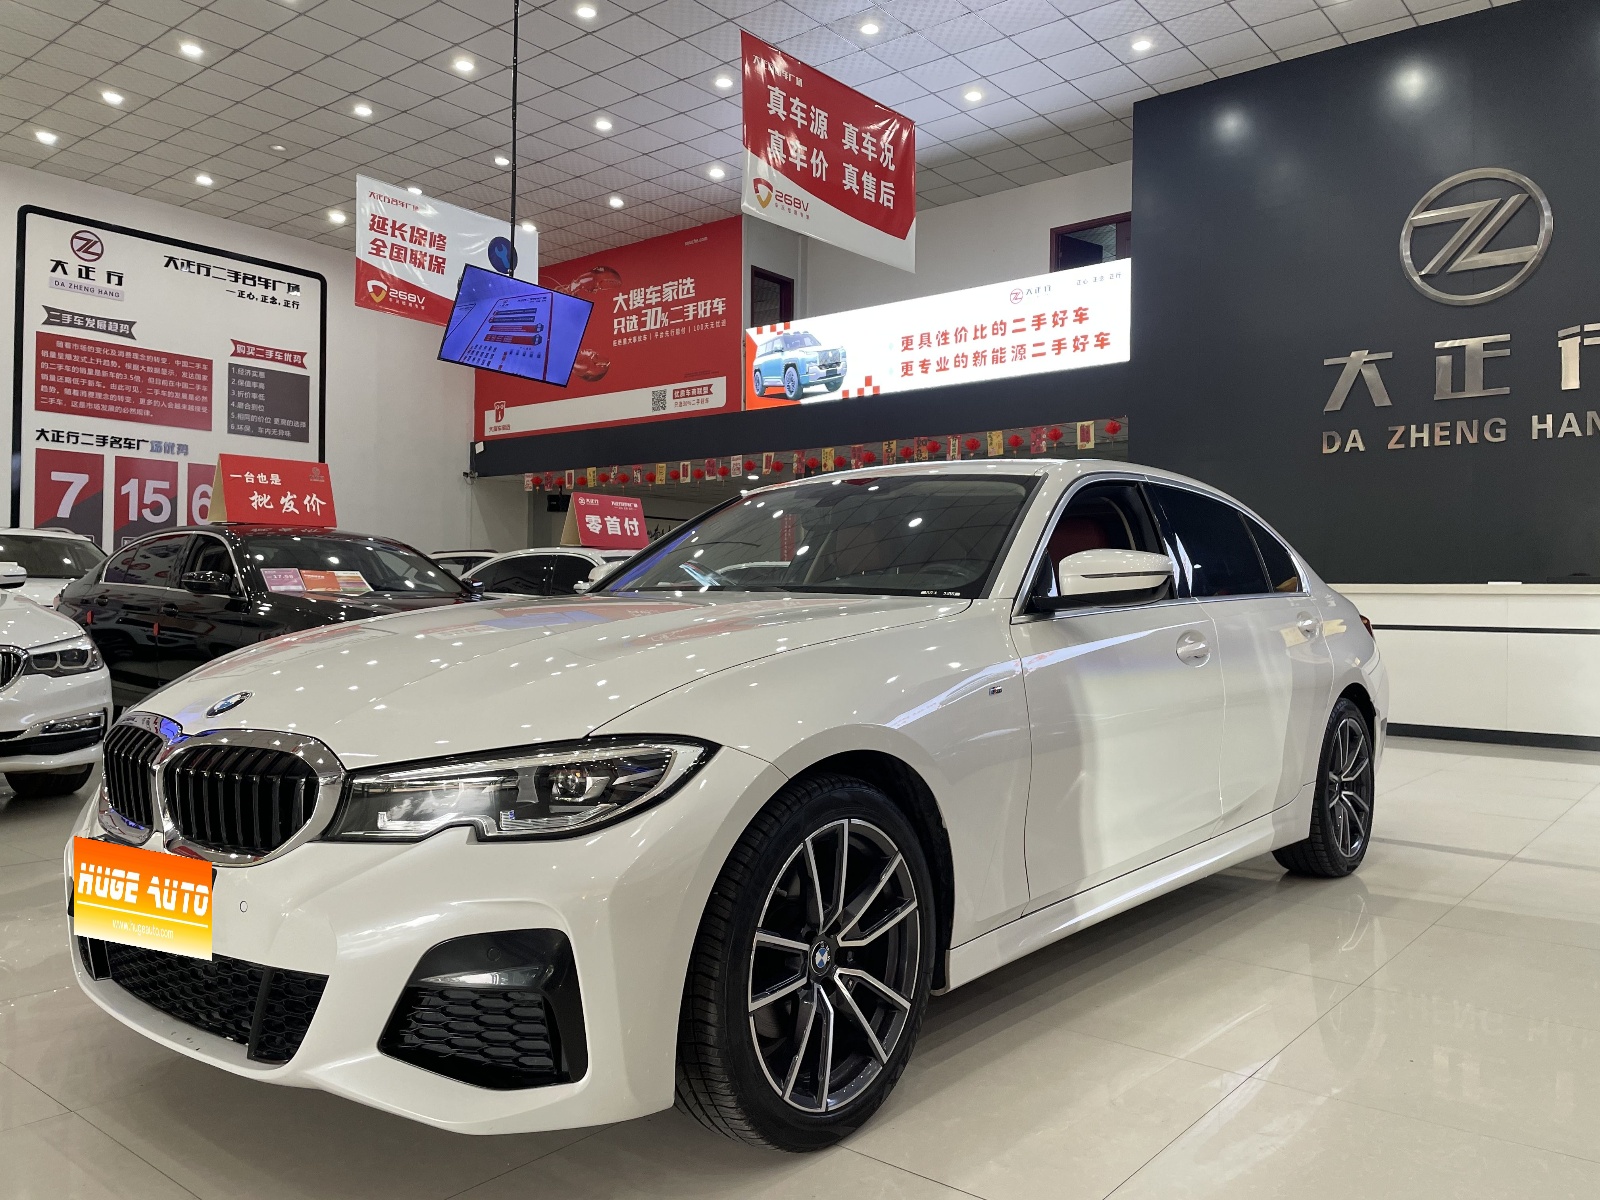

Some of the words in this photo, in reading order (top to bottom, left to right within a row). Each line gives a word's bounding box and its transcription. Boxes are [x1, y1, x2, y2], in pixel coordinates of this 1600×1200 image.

[766, 84, 828, 140] 真车源
[842, 121, 896, 172] 真车况
[767, 128, 829, 182] 真车价
[842, 162, 896, 210] 真售后
[774, 190, 810, 212] 268V
[368, 213, 447, 252] 延长保修
[50, 259, 124, 287] 大正行
[368, 237, 447, 276] 全国联保
[54, 280, 65, 288] DA
[68, 283, 95, 293] ZHENG
[98, 287, 120, 298] HANG
[163, 255, 301, 297] 大正行二手名车广场
[612, 276, 696, 314] 大搜车家选
[388, 288, 426, 305] 268V
[49, 311, 130, 334] 二手车发展趋势
[612, 297, 727, 335] 只选30%二手好车
[900, 306, 1091, 353] 更具性价比的二手好车
[236, 344, 302, 364] 购买二手车优势
[900, 331, 1111, 378] 更专业的新能源二手好车
[1322, 429, 1366, 454] DA
[1387, 417, 1508, 450] ZHENG
[50, 471, 90, 518] 7
[229, 471, 282, 486] 一台也是
[120, 478, 173, 524] 15
[249, 491, 327, 516] 批发价
[585, 514, 640, 537] 零首付
